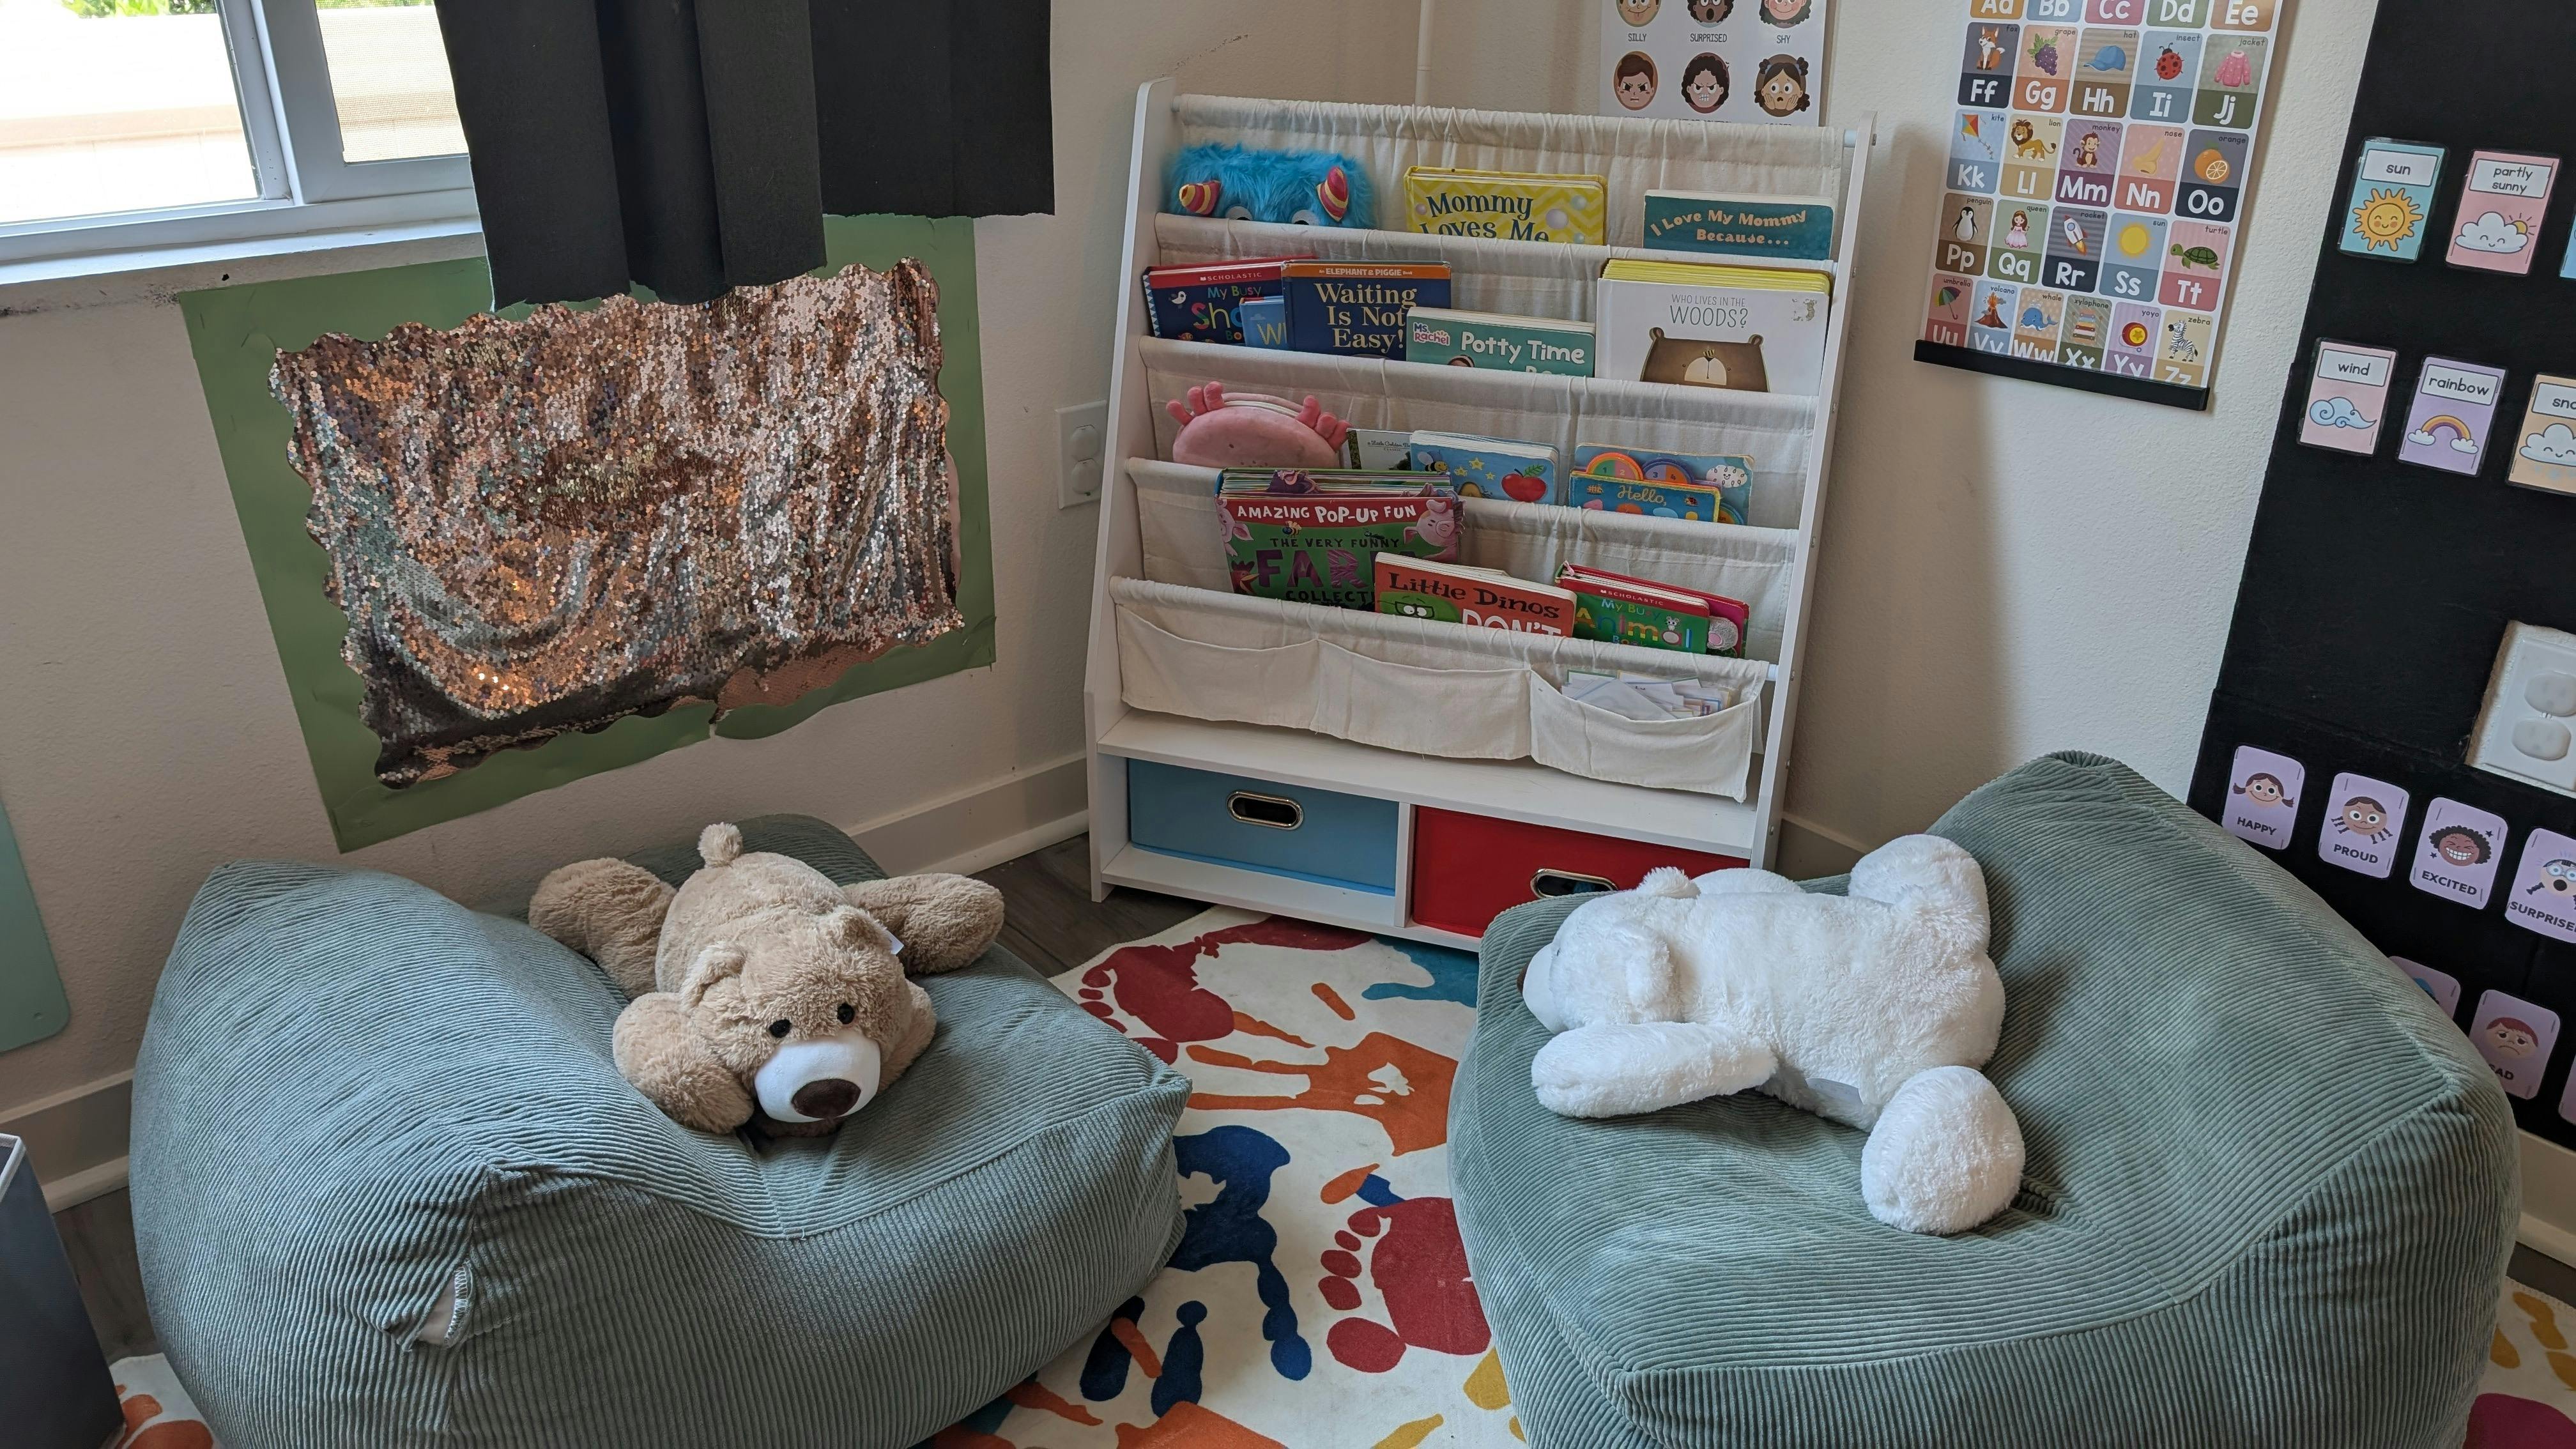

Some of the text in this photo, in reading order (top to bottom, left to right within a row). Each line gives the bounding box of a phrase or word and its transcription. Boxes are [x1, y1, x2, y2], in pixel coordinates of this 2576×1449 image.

[2039, 0, 2070, 17] Bb
[2099, 0, 2131, 19] Cc
[2159, 0, 2196, 23] Dd
[2225, 0, 2258, 25] Ee
[1628, 33, 1646, 42] SILLY
[1690, 33, 1728, 43] SURPRISED
[1776, 34, 1791, 44] SHY
[2055, 28, 2076, 36] grape
[2238, 38, 2266, 47] jacket
[1970, 79, 1998, 103] Ff
[2025, 80, 2057, 111] Gg
[2082, 88, 2114, 113] Hh
[2149, 91, 2172, 117] Ii
[2213, 95, 2236, 125] Jj
[1991, 114, 2004, 122] kite
[2048, 119, 2061, 127] lion
[2092, 125, 2120, 134] monkey
[2218, 136, 2246, 145] orange
[1957, 164, 1985, 188] Kk
[2386, 162, 2411, 176] sun
[2493, 166, 2533, 181] partly
[2017, 171, 2036, 195] Ll
[2060, 175, 2107, 203] Mm
[2492, 181, 2527, 195] sunny
[1966, 197, 1991, 206] penguin
[2126, 183, 2160, 209] Nn
[2188, 189, 2224, 215] Oo
[1426, 193, 1533, 221] Mommy
[1508, 219, 1549, 242] Me
[1650, 210, 1806, 236] I Love My Mommy
[2205, 226, 2228, 235] turtle
[1696, 229, 1789, 245] Because...
[1946, 243, 1975, 272] Pp
[1998, 252, 2030, 282] Qq
[1208, 272, 1262, 281] SCHOLASTIC
[1943, 278, 1971, 287] umbrella
[2055, 262, 2085, 287] Rr
[2114, 270, 2142, 296] Ss
[1208, 286, 1262, 300] My Busy
[1314, 283, 1417, 309] Waiting
[1990, 285, 2015, 295] volcano
[2042, 293, 2062, 302] whale
[2177, 279, 2202, 305] Tt
[1671, 294, 1746, 307] WHO LIVES IN THE
[2074, 298, 2109, 309] xylophone
[1326, 306, 1406, 326] Is Not
[1670, 305, 1748, 328] WOODS?
[2142, 309, 2159, 318] yoyo
[2188, 317, 2211, 325] zebra
[1414, 323, 1429, 333] Ms.
[1414, 331, 1450, 345] Rachel
[1933, 325, 1958, 346] Uu
[1332, 328, 1404, 353] Easy!
[1461, 332, 1584, 364] Potty Time
[1974, 332, 2004, 353] Vv
[2014, 339, 2055, 362] Ww
[2066, 348, 2095, 368] Xx
[2165, 366, 2192, 385] Zz
[2337, 362, 2370, 376] wind
[2428, 375, 2489, 396] rainbow
[1617, 485, 1667, 507] Hello,
[1238, 505, 1416, 523] AMAZING POP-UP FUN
[1270, 538, 1400, 548] THE VERY FUNNY
[1255, 549, 1416, 588] FAR
[1388, 572, 1560, 619] Little Dinos
[1601, 599, 1623, 612] My
[1608, 590, 1664, 606] SCHOLASTIC
[2237, 816, 2276, 836] HAPPY
[2334, 844, 2378, 864] PROUD
[2422, 870, 2477, 895] EXCITED
[2510, 901, 2576, 933] SURPRISE
